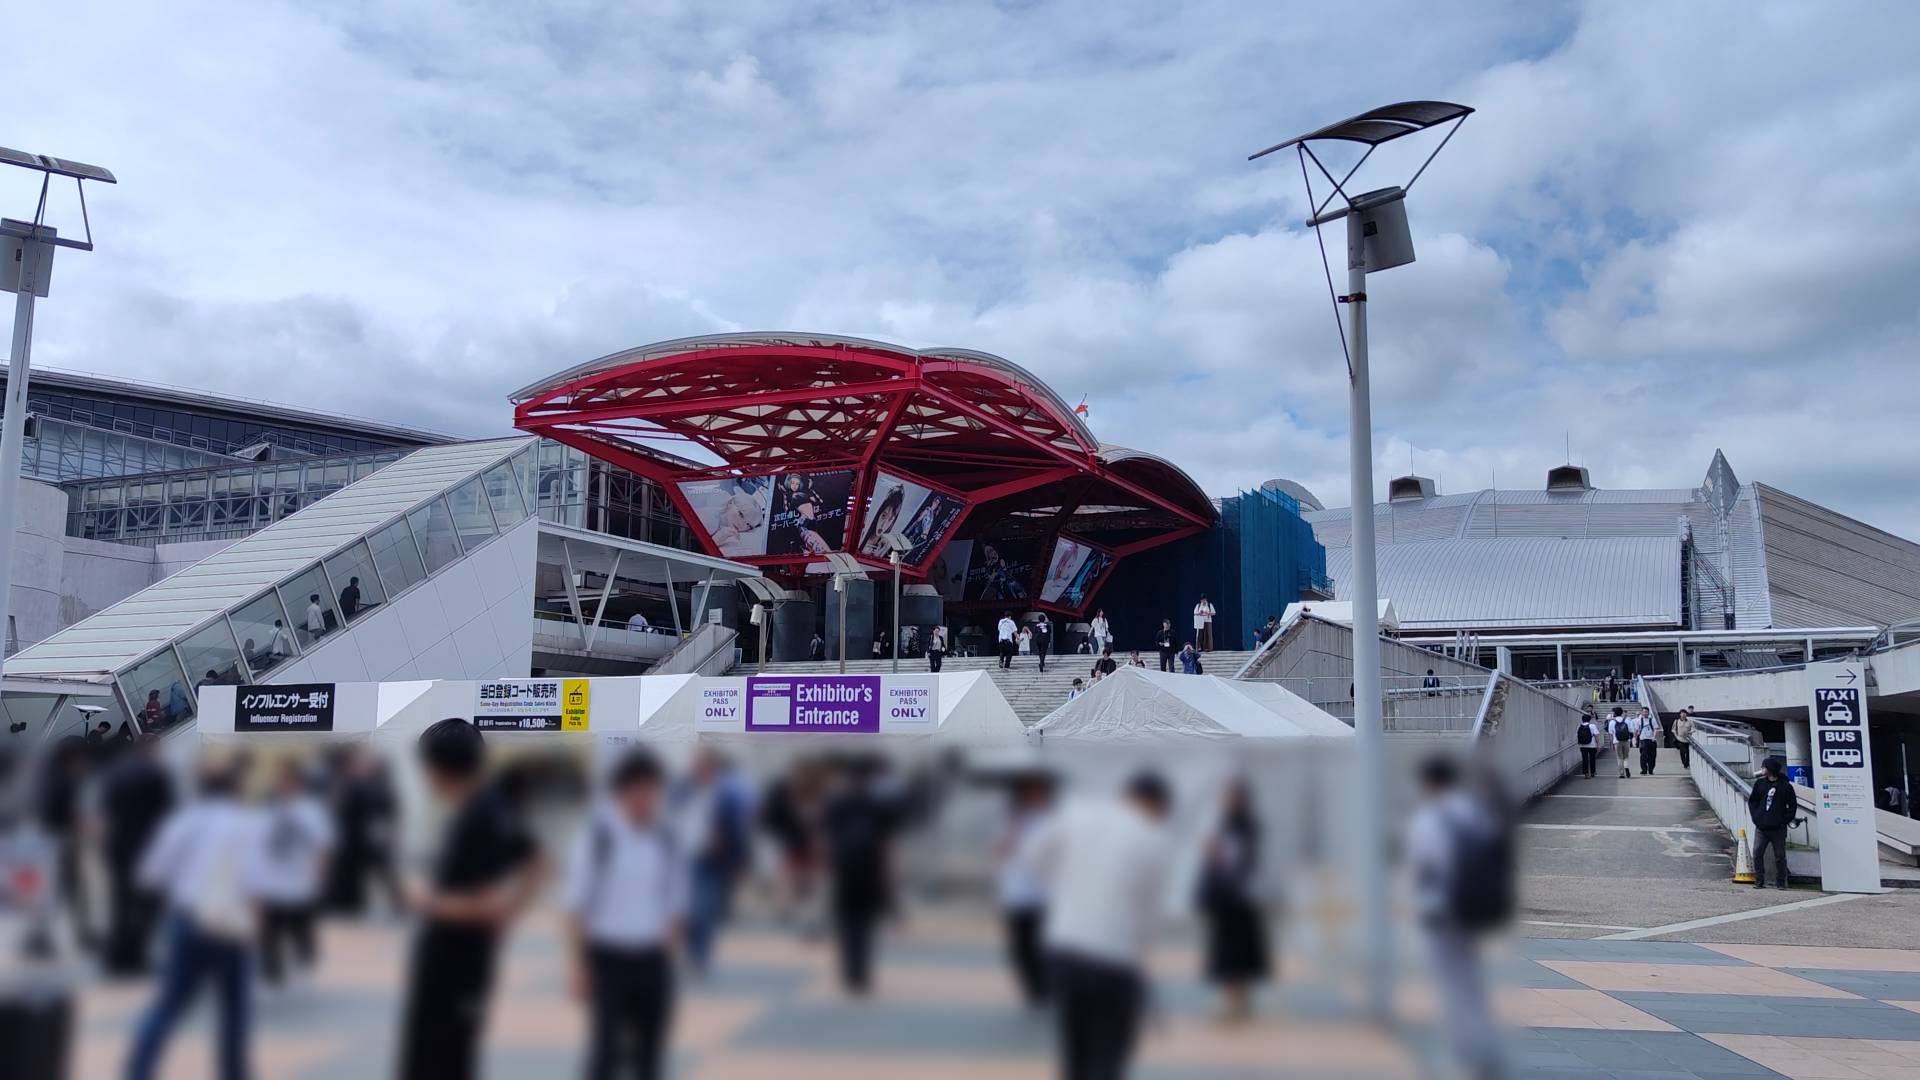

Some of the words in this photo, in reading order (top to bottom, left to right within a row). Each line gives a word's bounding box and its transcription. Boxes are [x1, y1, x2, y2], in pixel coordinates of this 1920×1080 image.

[480, 683, 557, 699] 当日登録コード販売所
[703, 689, 738, 697] EXHIBITOR
[796, 683, 873, 702] Exhibitor's
[889, 689, 928, 697] EXHIBITOR
[1817, 690, 1855, 700] TAXI
[241, 691, 329, 709] インフルエンサー受付
[705, 707, 736, 717] ONLY
[795, 706, 860, 725] Entrance
[891, 707, 926, 718] ONLY
[250, 714, 280, 723] Influencer
[280, 713, 318, 724] Registration
[1825, 731, 1856, 742] BUS
